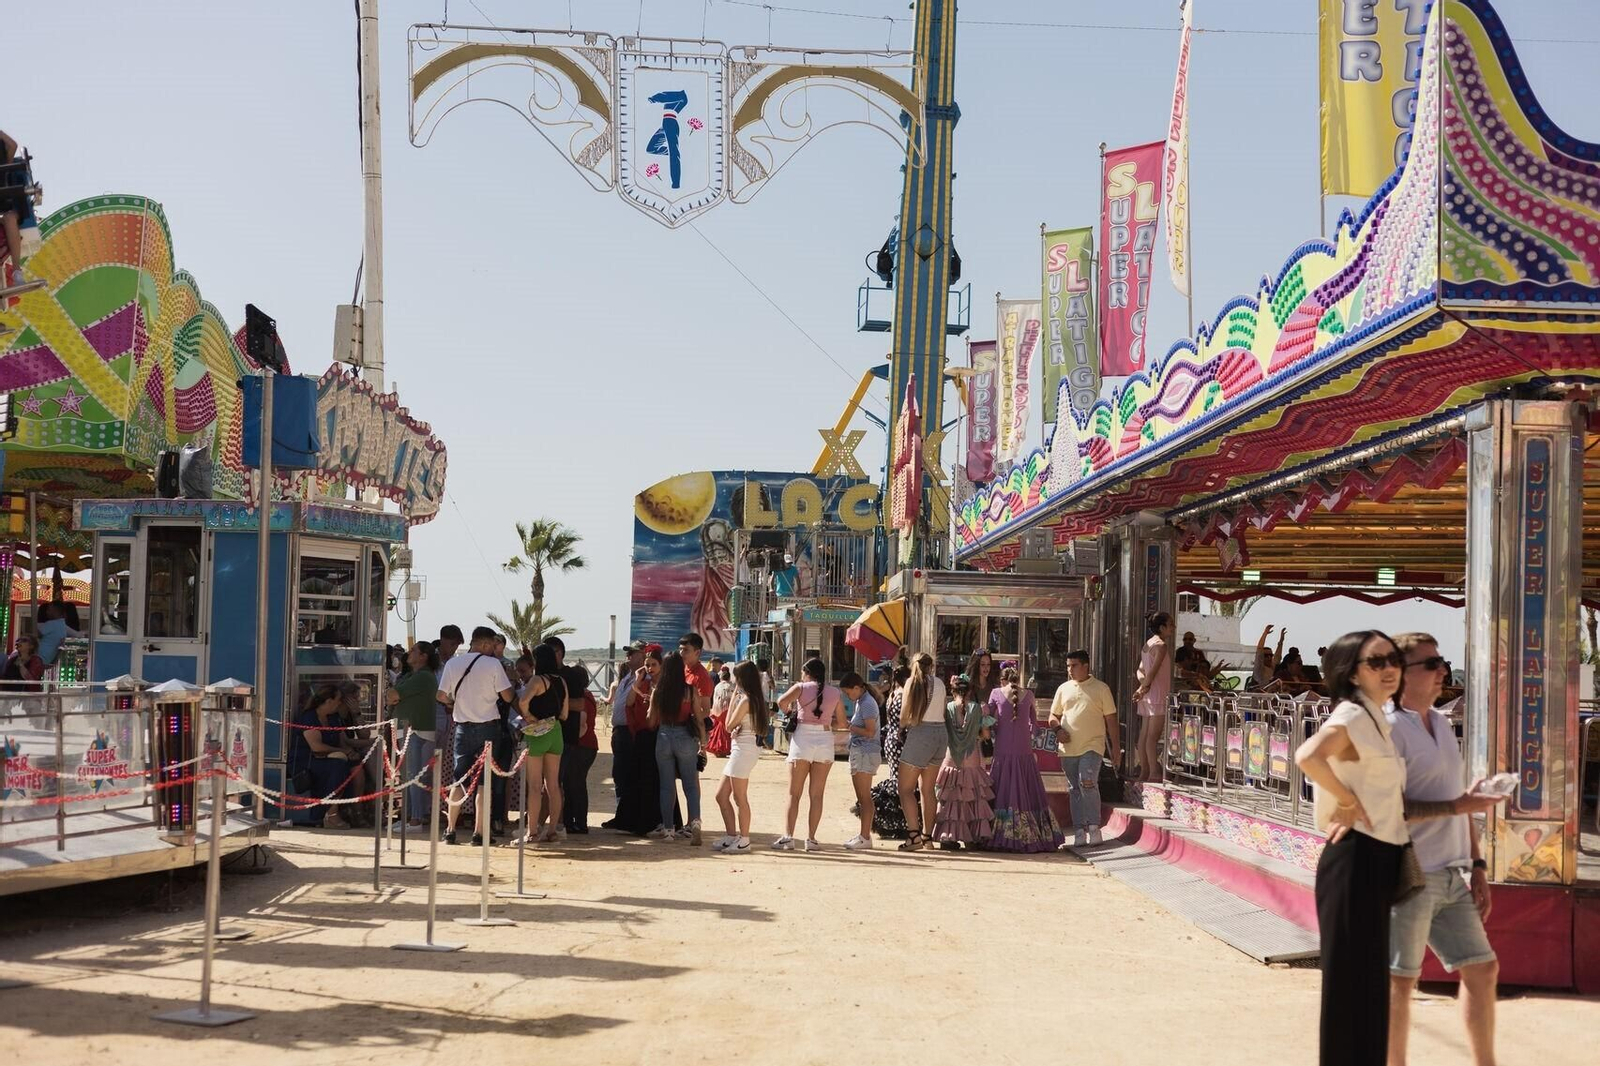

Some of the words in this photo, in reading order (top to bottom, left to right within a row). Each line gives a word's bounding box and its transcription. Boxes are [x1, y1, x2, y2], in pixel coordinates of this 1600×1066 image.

[1107, 161, 1138, 310] SUPER
[1047, 244, 1069, 366] SUPER
[1065, 260, 1098, 411] LÁTIGO
[317, 378, 447, 513] TAMONTES
[973, 351, 996, 443] SUPER
[1147, 555, 1157, 613] SUPE
[1526, 461, 1546, 596] SUPER
[810, 612, 855, 620] TAQUILLA
[86, 748, 116, 764] SUPER
[1523, 627, 1543, 793] LATIGO
